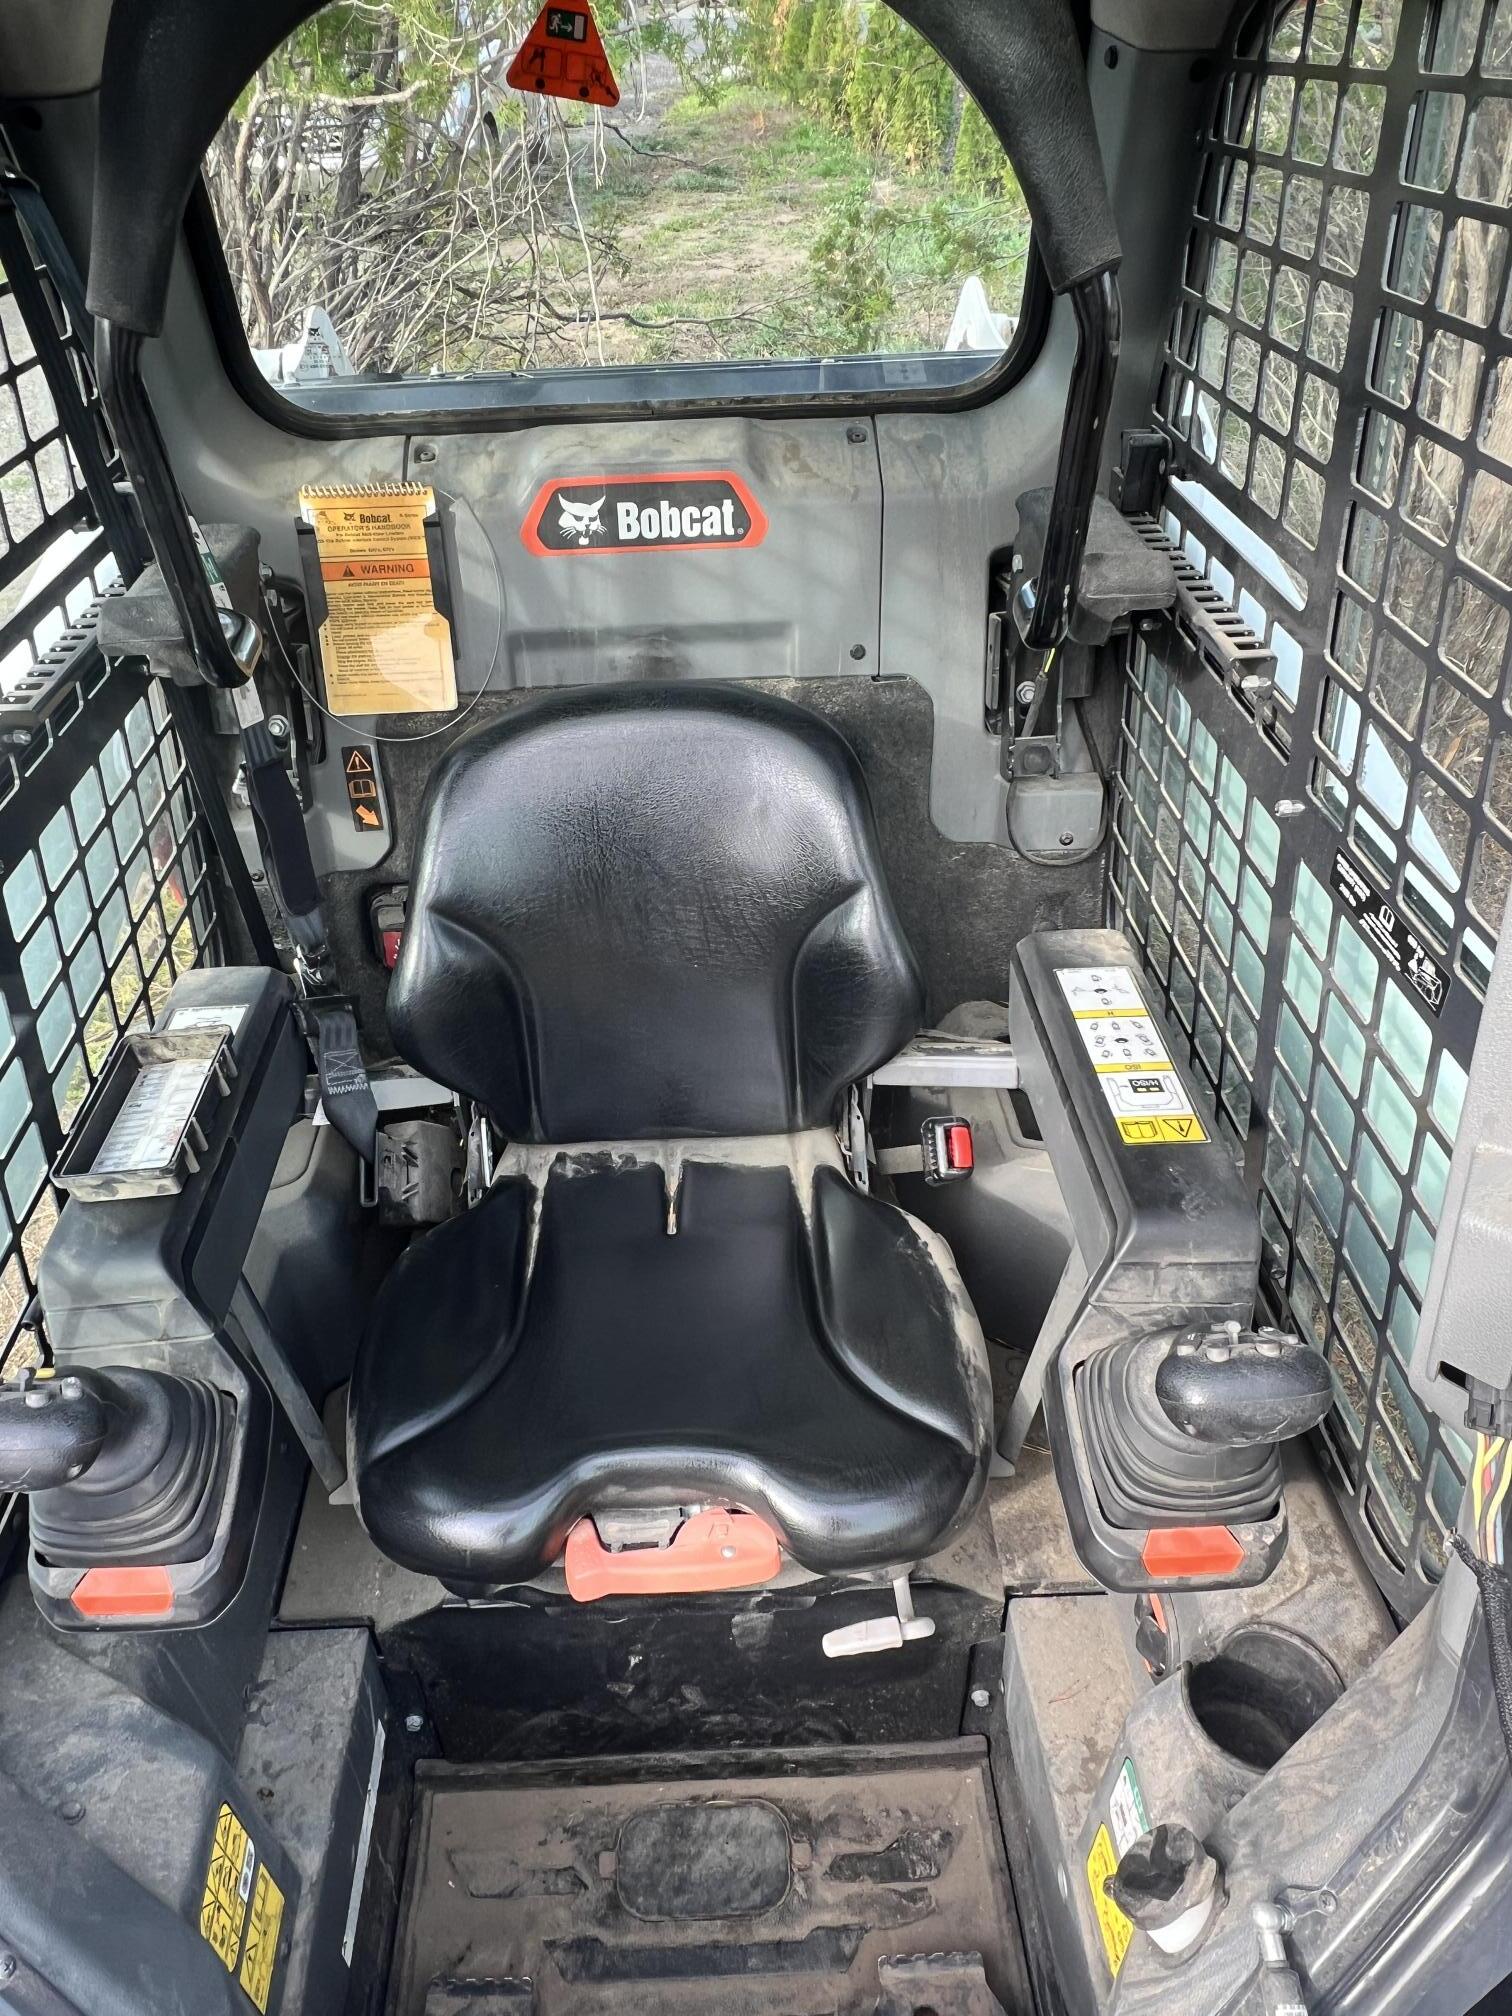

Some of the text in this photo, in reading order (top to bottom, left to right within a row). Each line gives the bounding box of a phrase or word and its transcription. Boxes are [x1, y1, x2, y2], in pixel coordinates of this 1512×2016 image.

[359, 513, 391, 524] Bobcat
[616, 498, 735, 540] Bobcat
[360, 563, 414, 575] WARNING
